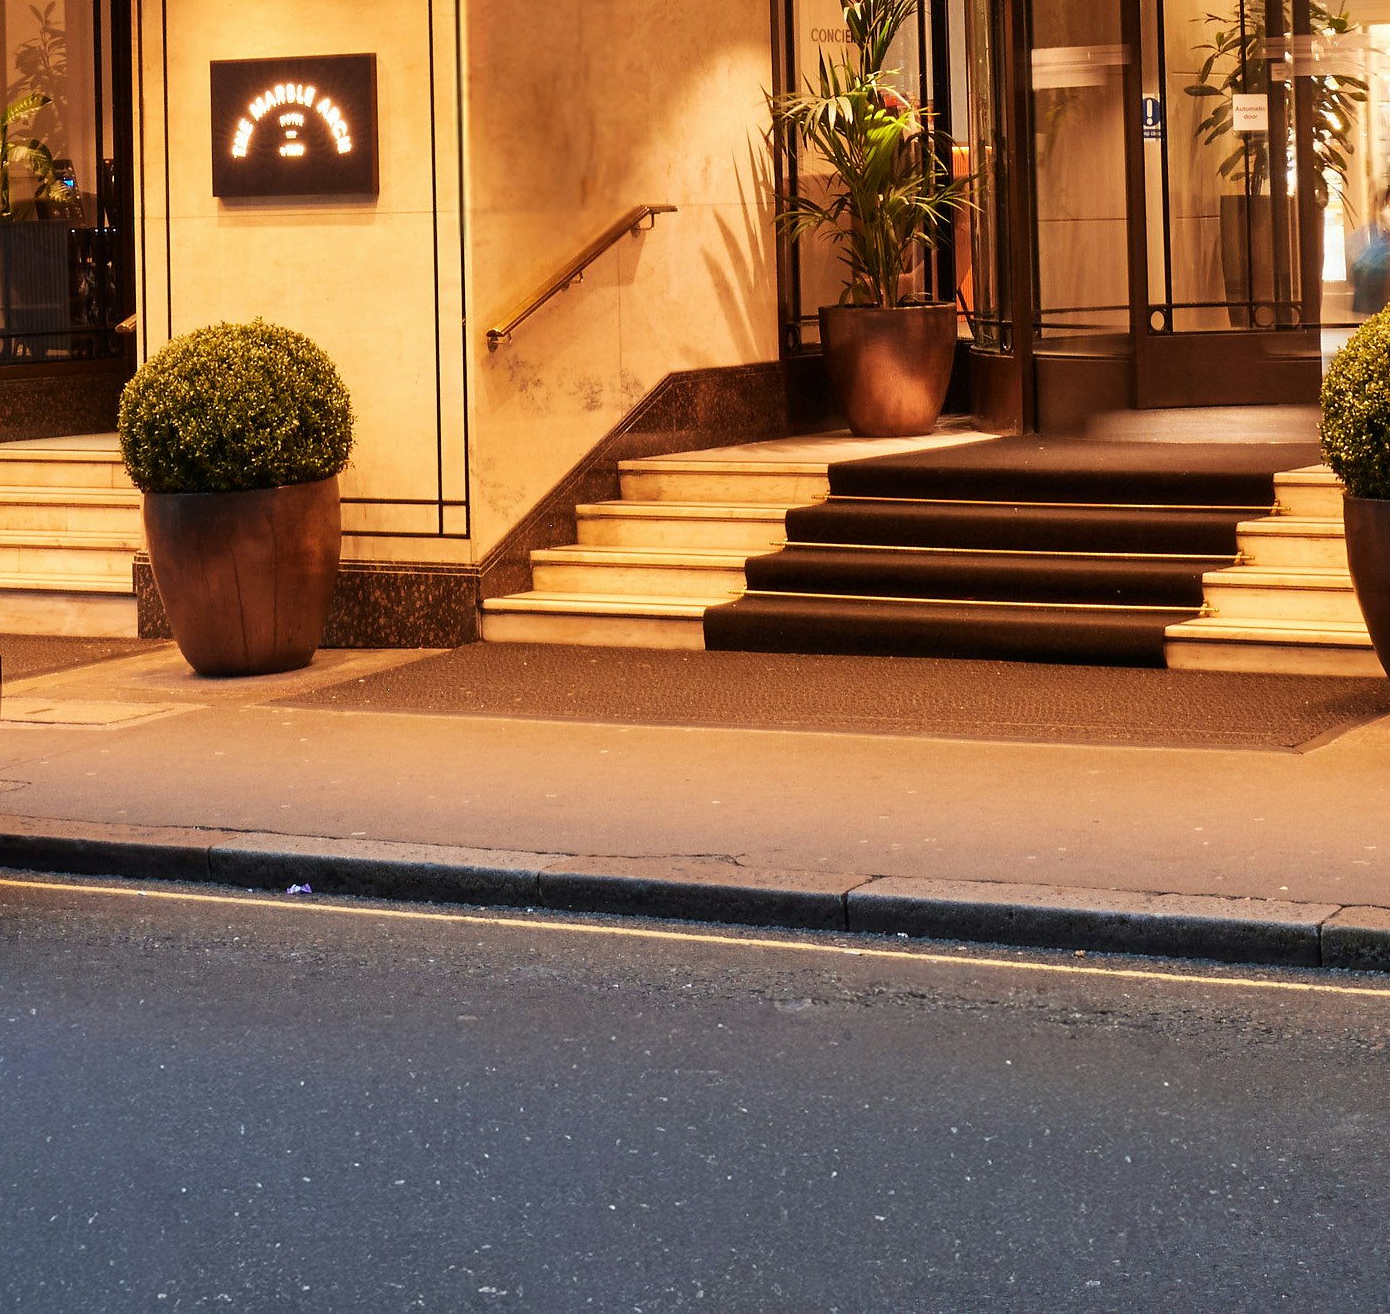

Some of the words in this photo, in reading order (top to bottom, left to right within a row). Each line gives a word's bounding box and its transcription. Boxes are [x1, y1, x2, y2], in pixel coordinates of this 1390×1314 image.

[810, 27, 856, 43] CONCIE
[249, 83, 316, 122] MARBLE
[316, 98, 352, 154] ARCH
